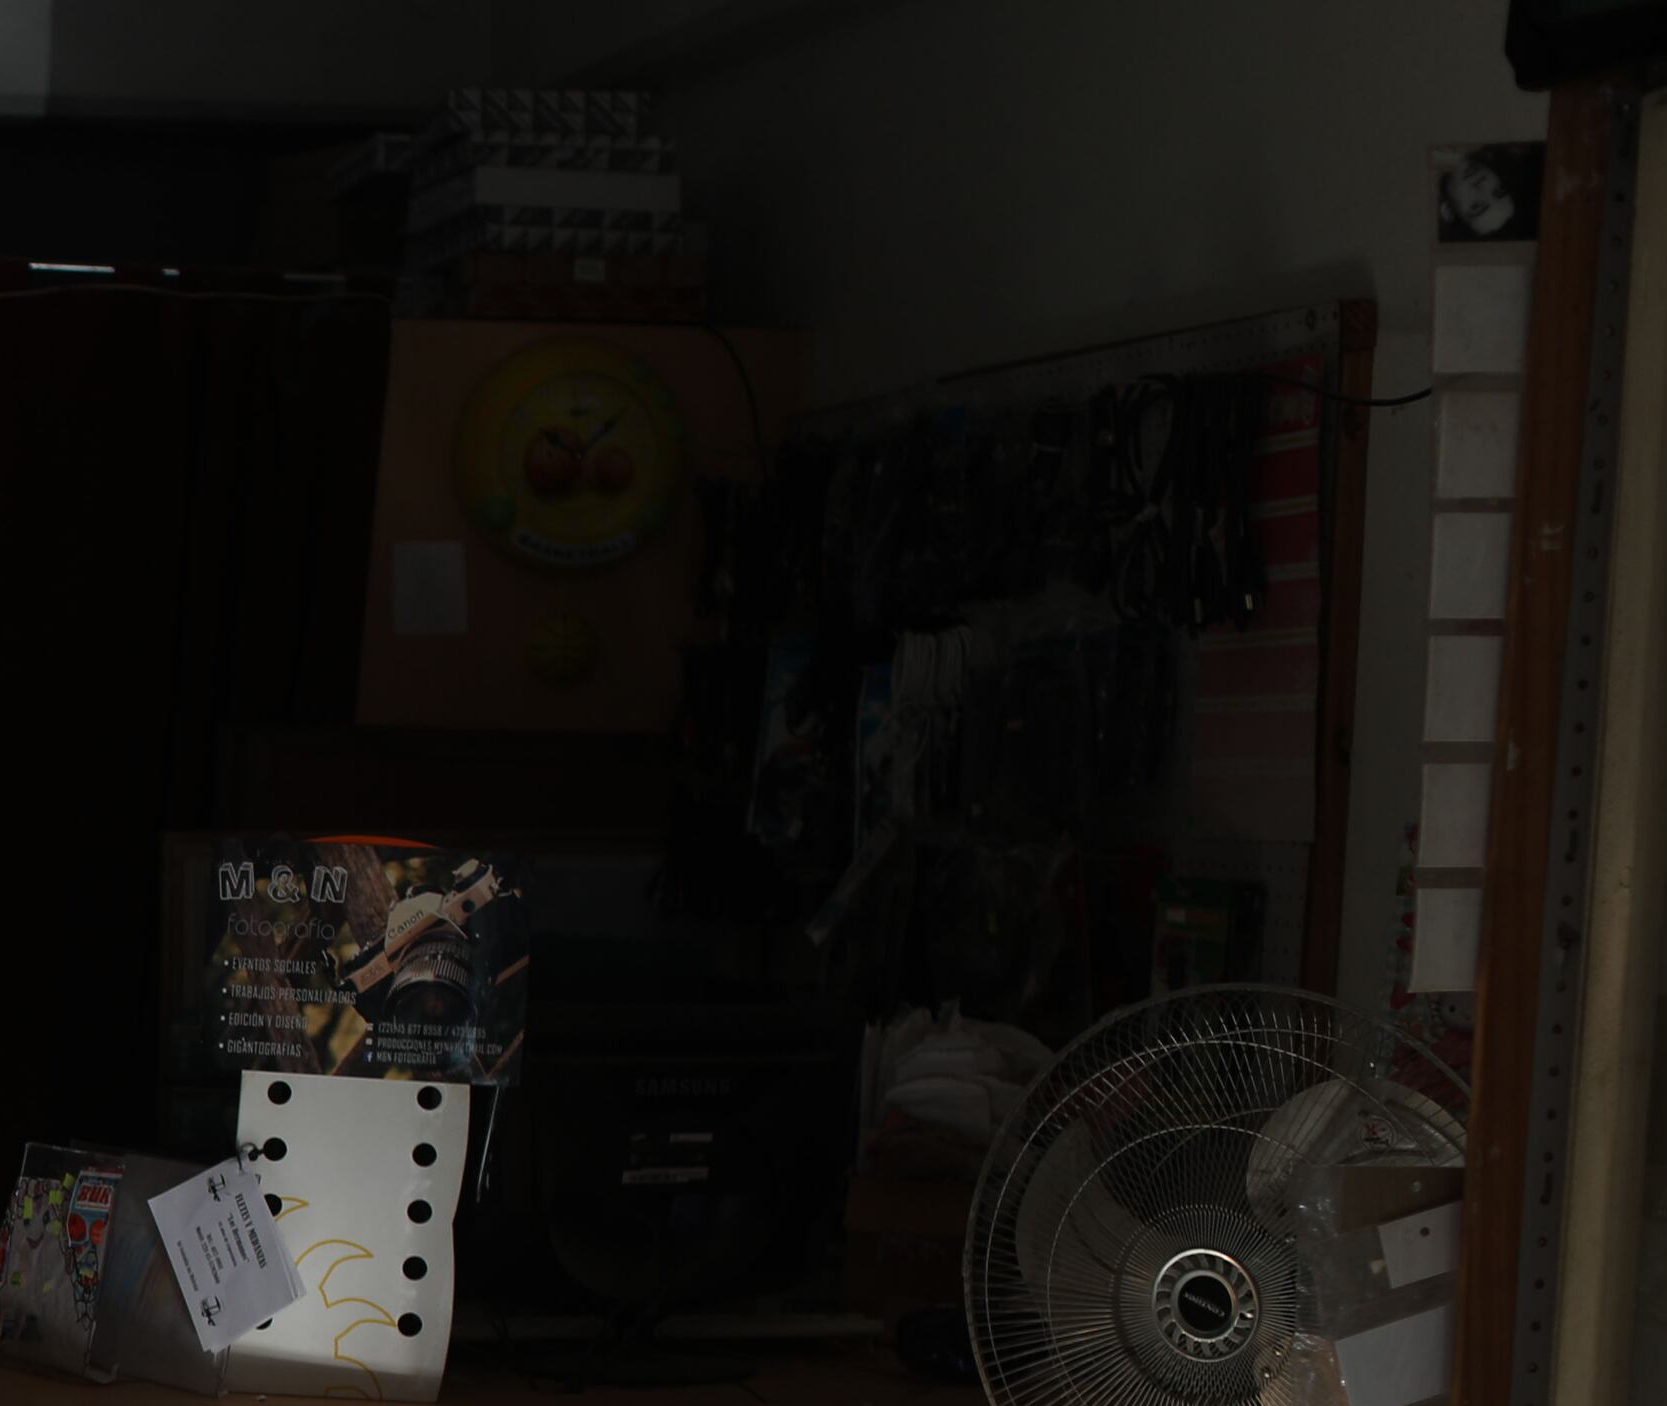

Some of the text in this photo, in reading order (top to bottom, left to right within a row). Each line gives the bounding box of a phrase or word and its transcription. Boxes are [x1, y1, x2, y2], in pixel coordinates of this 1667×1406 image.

[218, 861, 348, 904] M & N
[387, 909, 424, 939] Canon
[231, 957, 317, 975] EVENTOS SOCIALES
[230, 985, 357, 1005] TRABAJOS PERSONALIZADOS
[228, 1011, 308, 1030] EDICIÓN Y DISEÑO
[633, 1076, 731, 1097] SAMSUNG
